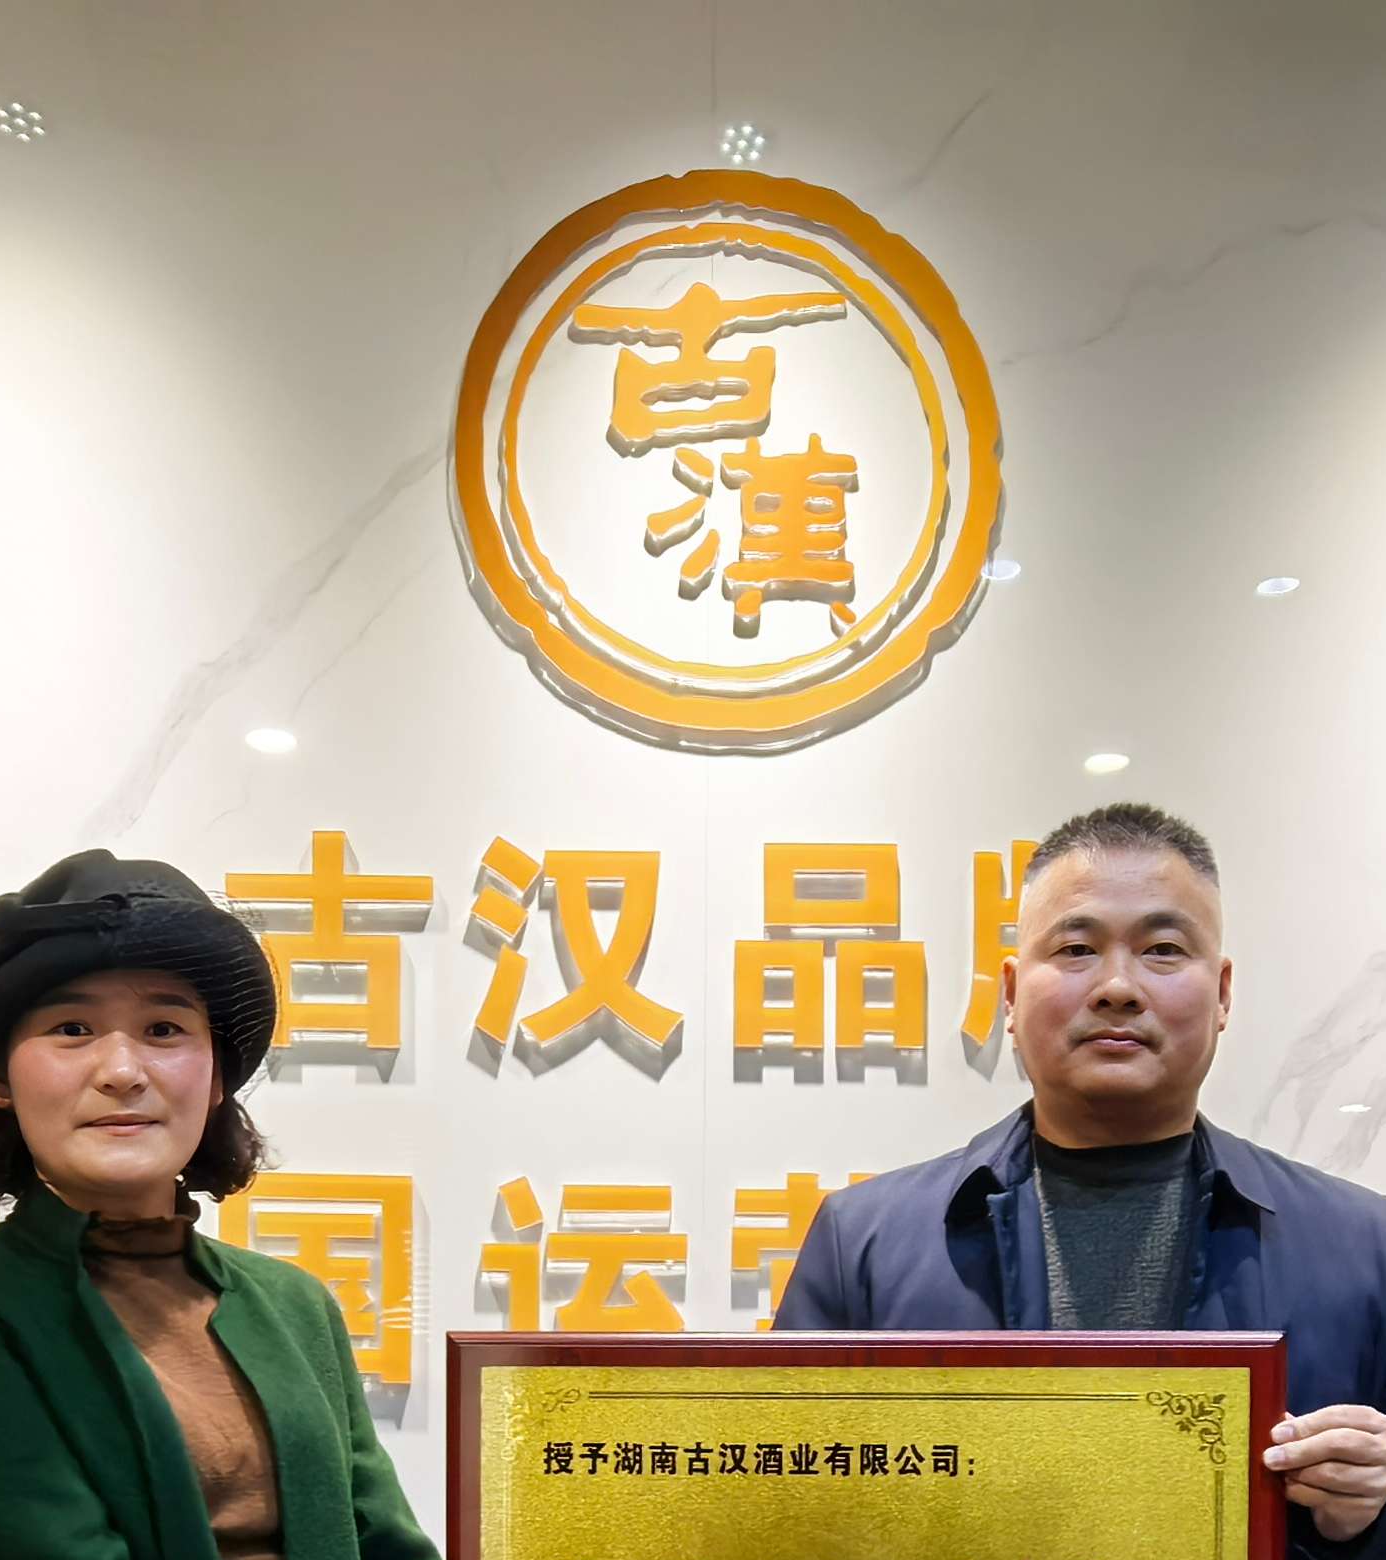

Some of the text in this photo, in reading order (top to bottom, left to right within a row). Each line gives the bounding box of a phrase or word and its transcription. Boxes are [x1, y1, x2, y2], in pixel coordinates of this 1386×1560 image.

[225, 830, 1038, 1050] 古汉品
[216, 1172, 875, 1384] 国运
[543, 1441, 975, 1477] 授予湖南古汉酒业有限公司：
